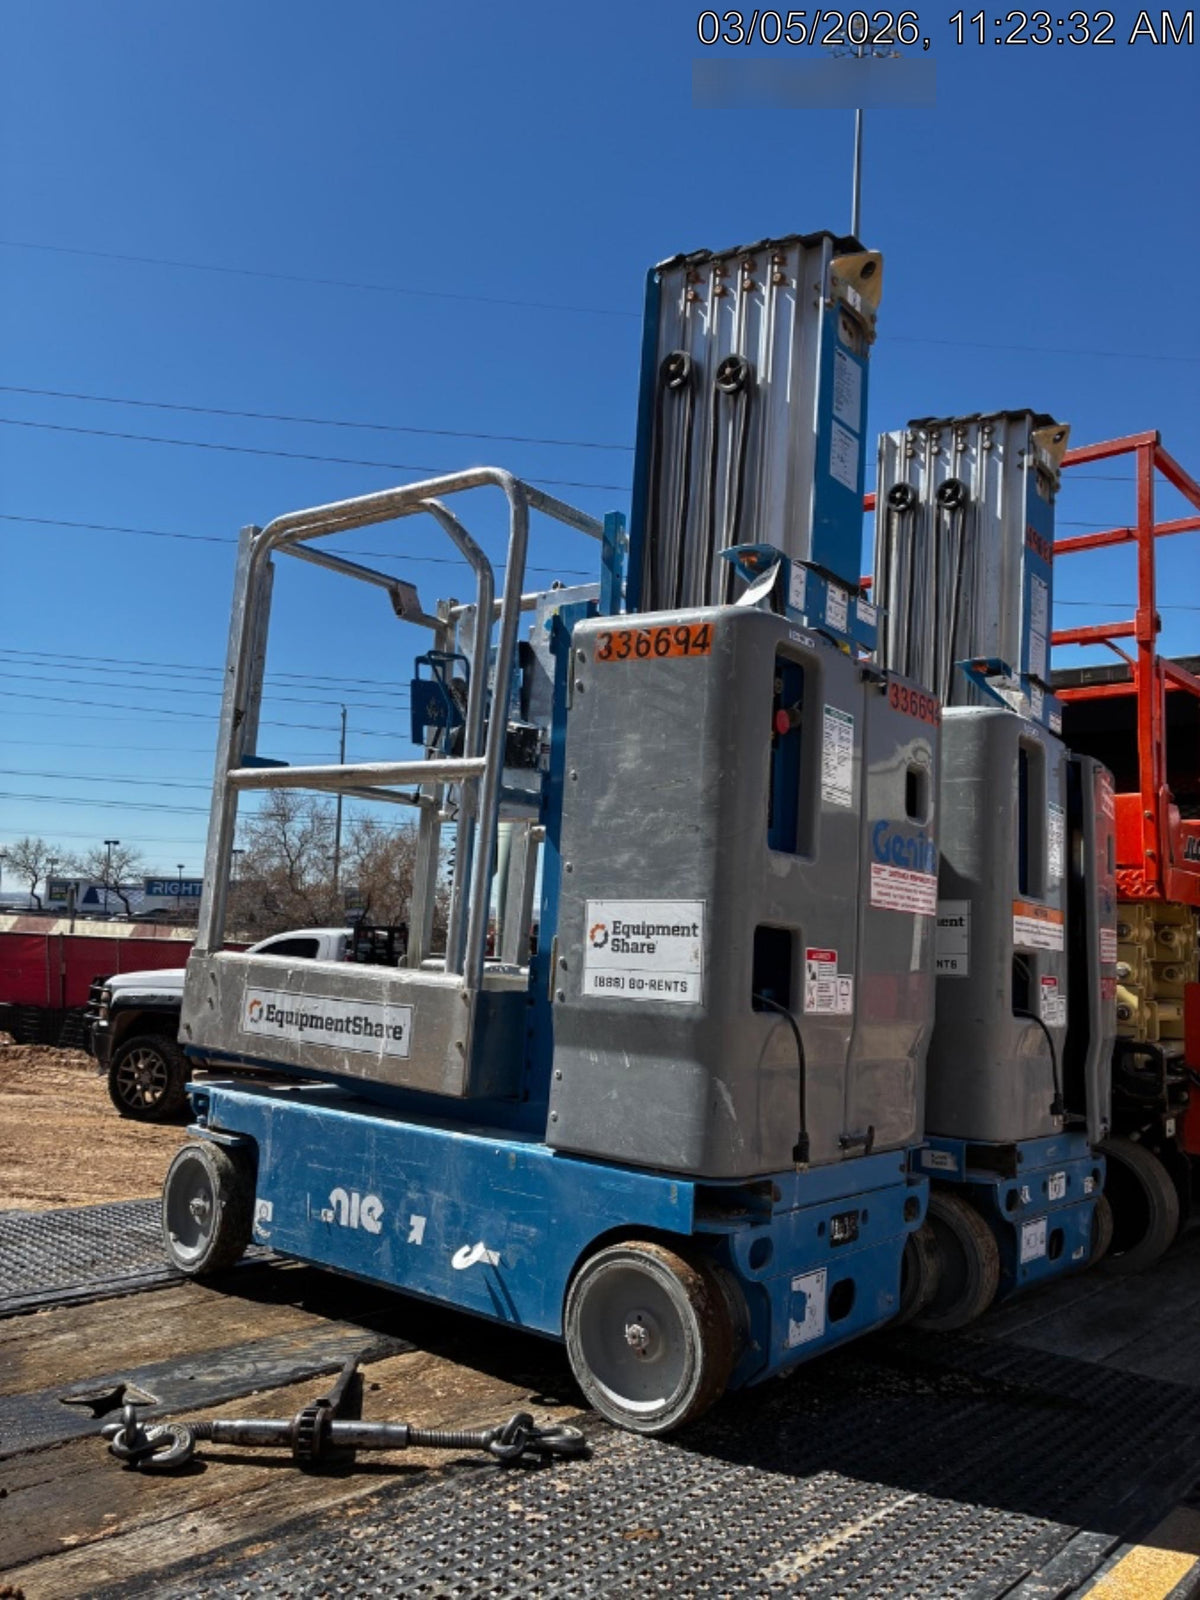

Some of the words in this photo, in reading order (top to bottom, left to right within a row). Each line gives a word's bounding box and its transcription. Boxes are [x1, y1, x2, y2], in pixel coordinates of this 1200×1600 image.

[597, 623, 711, 660] 336694
[611, 920, 700, 939] Equipment
[610, 938, 656, 954] Share
[265, 1003, 403, 1041] EquipmentShare
